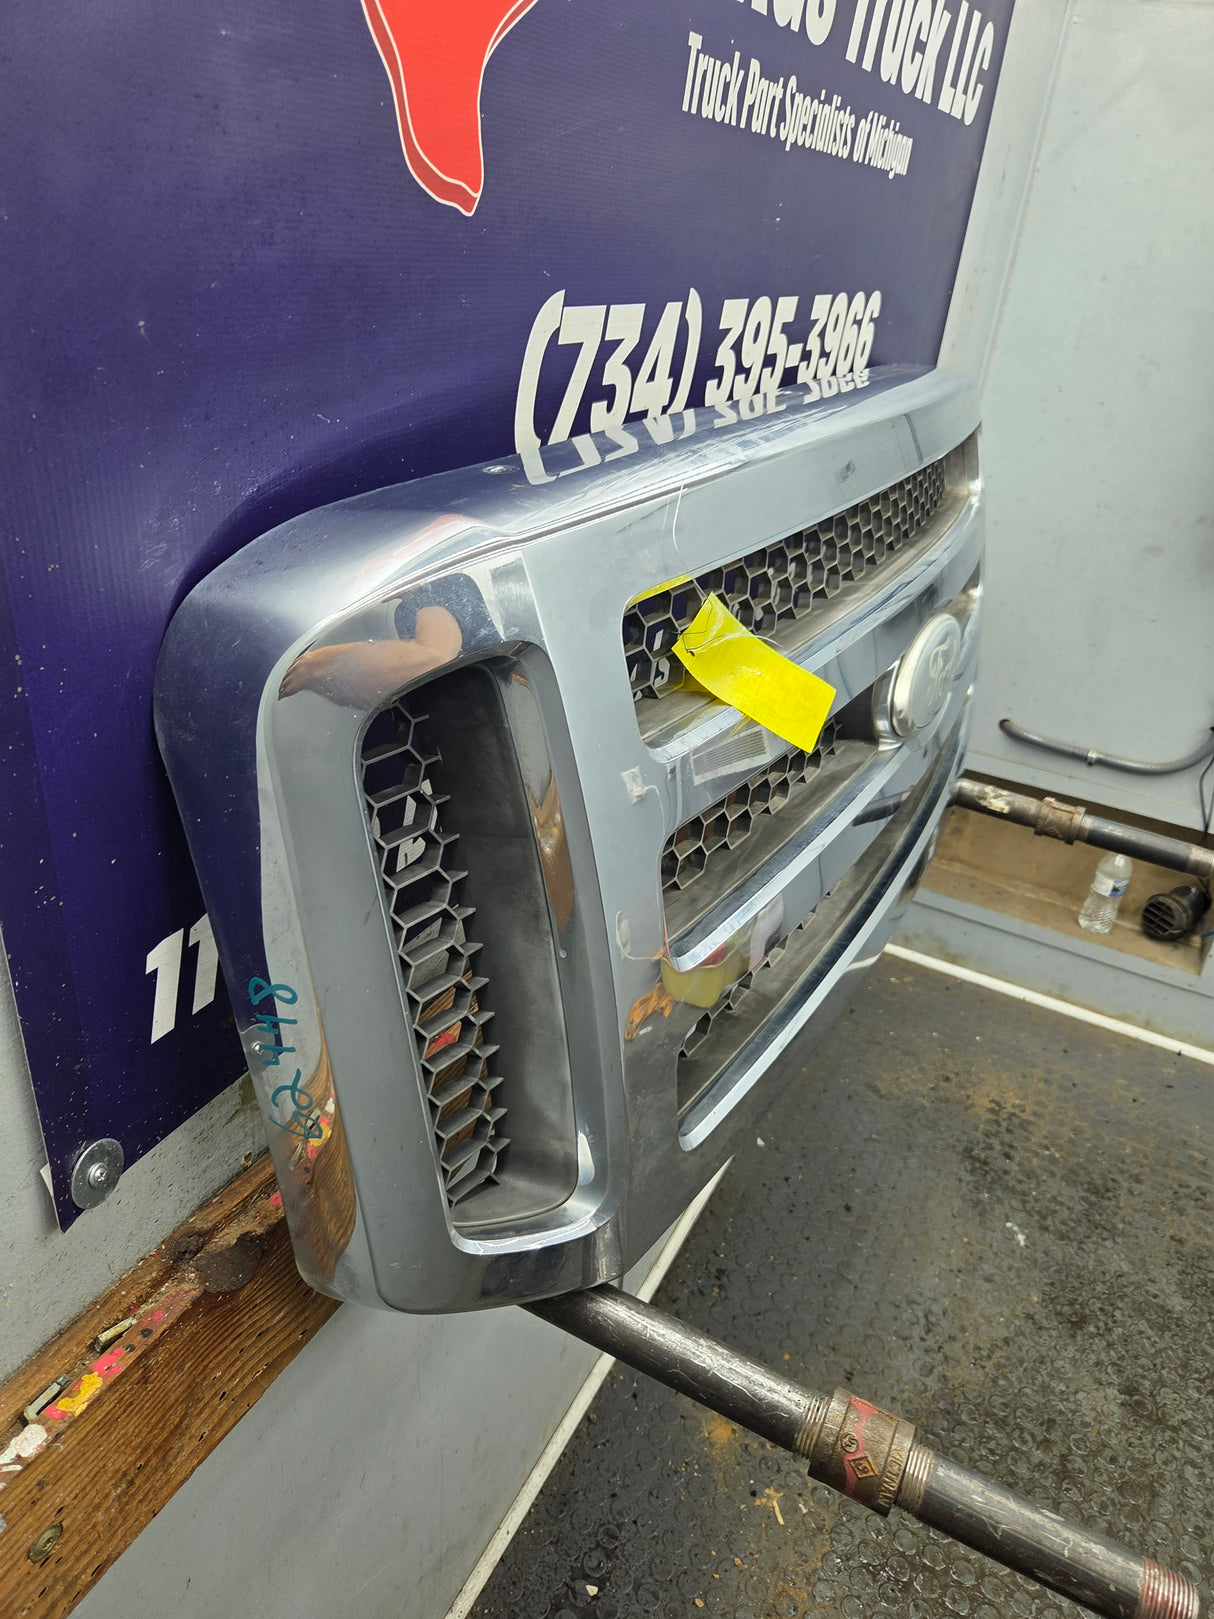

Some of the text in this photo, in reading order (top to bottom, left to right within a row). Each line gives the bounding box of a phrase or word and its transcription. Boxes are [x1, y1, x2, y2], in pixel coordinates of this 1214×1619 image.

[682, 31, 913, 179] Truck Part Specialists of Michigan
[938, 0, 994, 125] LLC
[515, 288, 882, 453] (734) 395-3966
